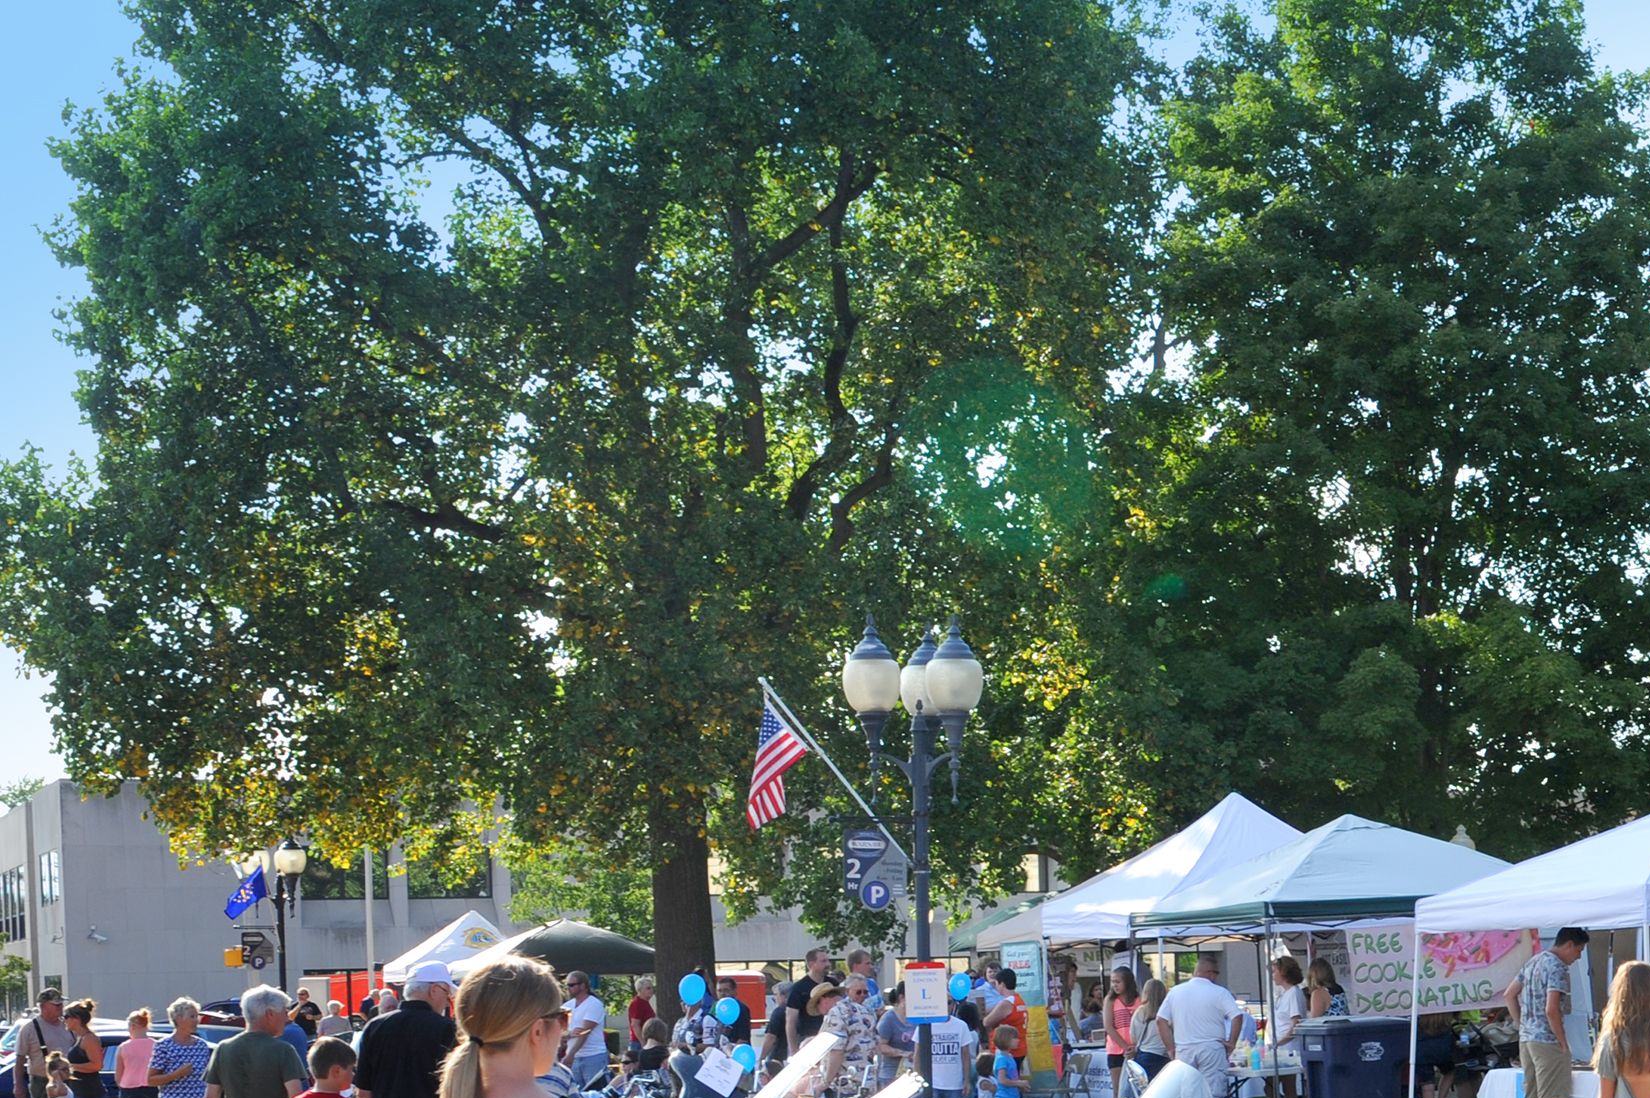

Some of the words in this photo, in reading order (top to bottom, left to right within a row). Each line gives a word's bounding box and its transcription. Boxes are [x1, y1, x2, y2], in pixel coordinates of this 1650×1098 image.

[846, 858, 861, 879] 2
[847, 882, 859, 890] Hr
[871, 885, 885, 904] P
[1352, 932, 1403, 955] FREE
[1354, 958, 1436, 983] COOKE
[931, 1043, 958, 1055] OUTTA
